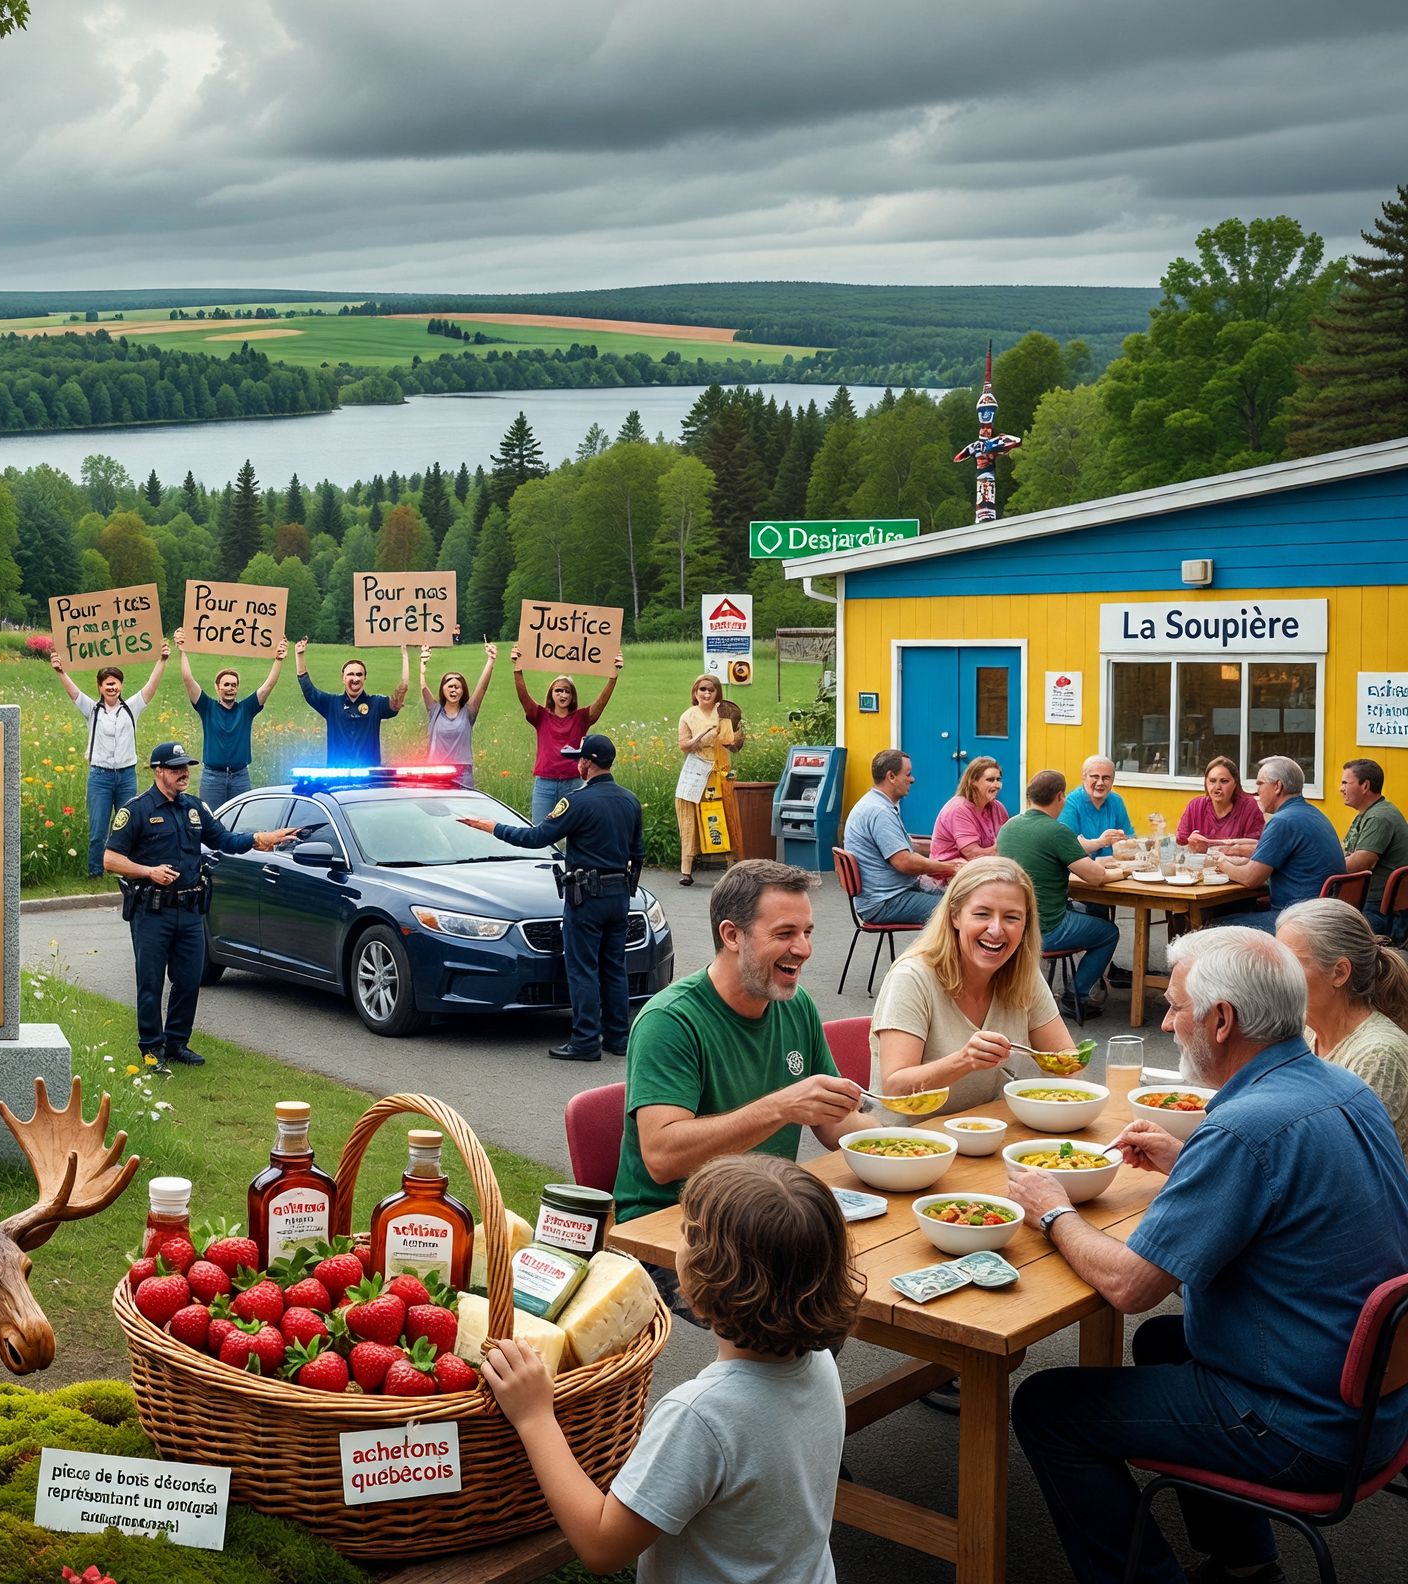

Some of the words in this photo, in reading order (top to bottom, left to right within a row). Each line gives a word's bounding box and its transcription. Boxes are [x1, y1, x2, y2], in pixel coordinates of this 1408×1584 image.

[194, 584, 238, 612] Pour
[362, 576, 405, 601] Pour
[57, 598, 102, 622] Pour
[365, 603, 445, 634] forêts
[529, 606, 611, 636] Justice
[193, 614, 273, 648] forêts
[1123, 611, 1156, 639] La
[1165, 605, 1299, 647] Soupière
[535, 632, 602, 664] locale
[352, 1435, 449, 1464] achetons
[95, 1468, 112, 1483] de
[144, 1497, 162, 1510] un
